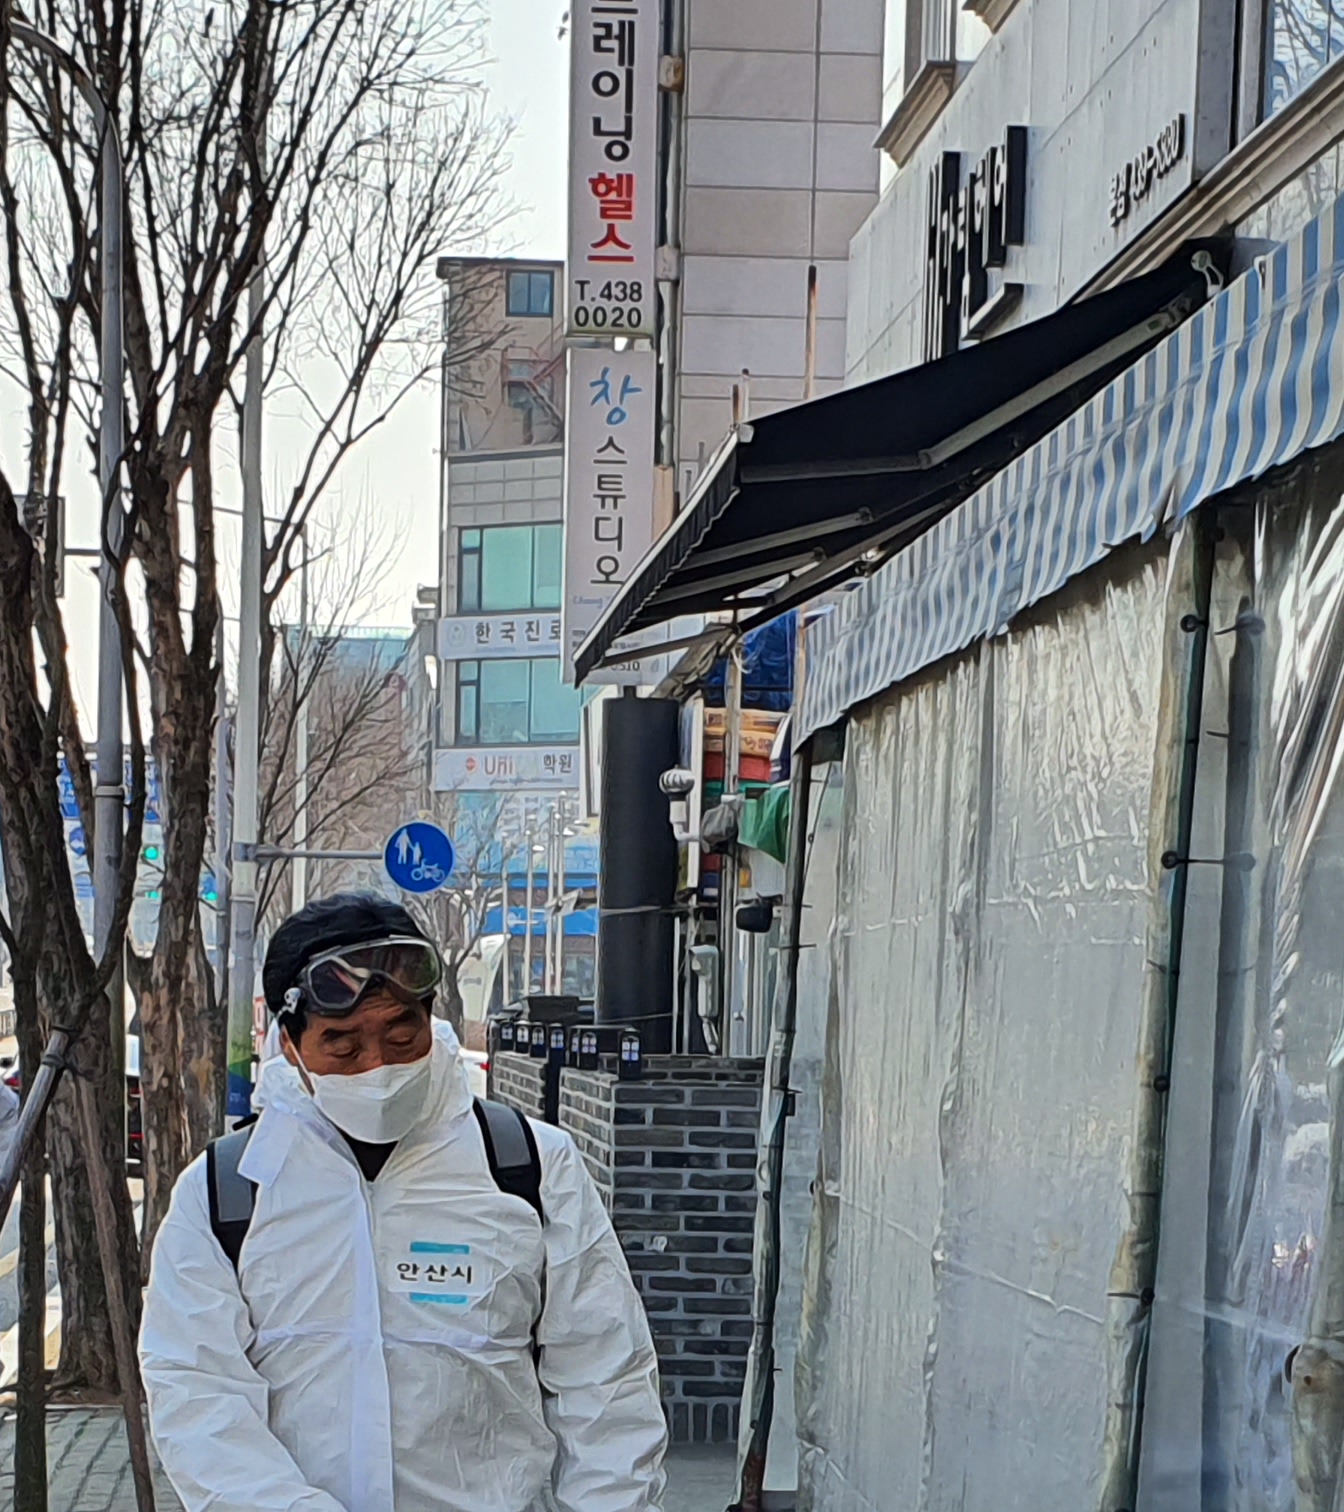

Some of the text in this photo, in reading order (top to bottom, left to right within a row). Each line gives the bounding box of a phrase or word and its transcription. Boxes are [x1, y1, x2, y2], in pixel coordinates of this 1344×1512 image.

[587, 172, 634, 262] 헬스
[574, 280, 643, 303] T.438
[574, 305, 642, 328] 0020
[588, 366, 643, 586] 창 스튜디오
[396, 1262, 473, 1285] 안산시
